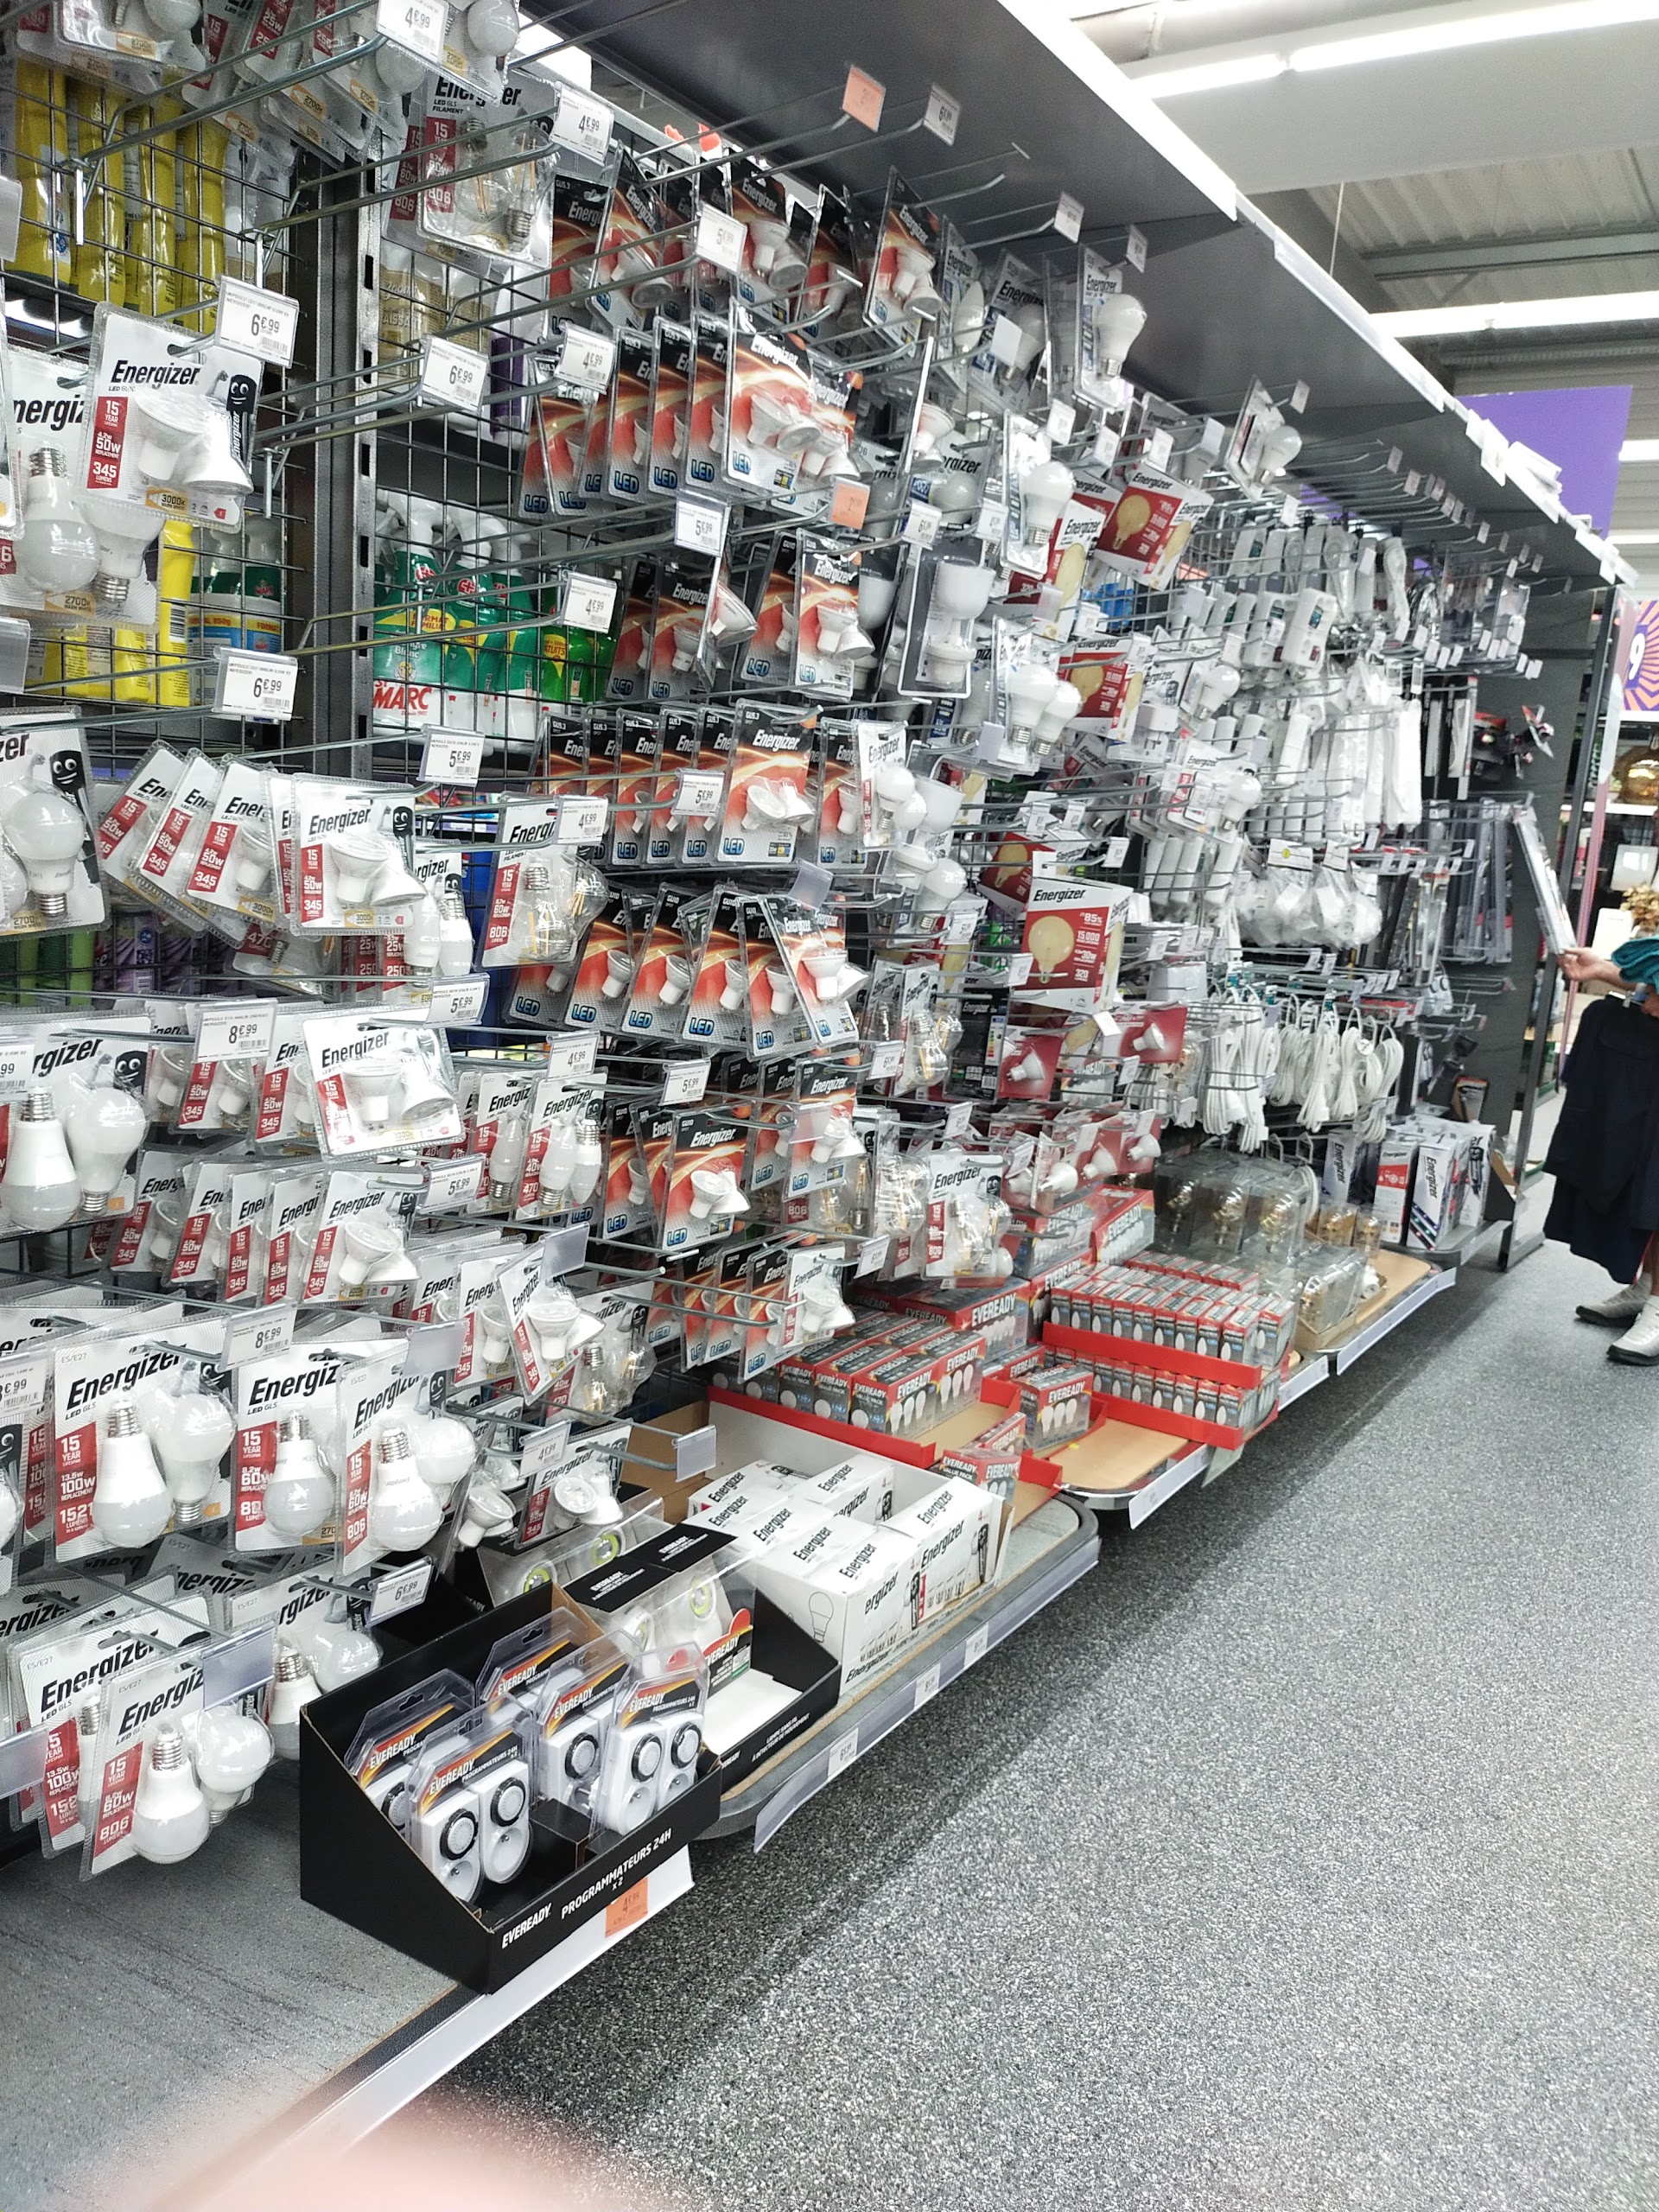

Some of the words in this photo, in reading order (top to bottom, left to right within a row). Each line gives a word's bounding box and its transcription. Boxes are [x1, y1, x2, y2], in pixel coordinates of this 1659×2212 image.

[405, 7, 430, 28] 4€99
[579, 116, 600, 133] 4€99
[251, 314, 279, 335] 6€99
[582, 352, 603, 369] 4€99
[111, 360, 200, 389] Energizer
[449, 366, 473, 385] 6€99
[106, 401, 119, 416] 15
[105, 415, 118, 423] YEAR
[96, 438, 121, 452] 50w
[93, 462, 117, 477] 345
[654, 467, 677, 489] LED
[691, 460, 715, 481] LED
[614, 472, 639, 493] LED
[1134, 473, 1173, 490] Energizer
[696, 519, 712, 536] 5€99
[1064, 518, 1102, 536] Energizer
[253, 677, 282, 697] 6€99
[374, 687, 432, 709] MARC
[753, 730, 800, 751] Energizer
[448, 752, 471, 767] 5€99
[696, 790, 713, 804] 5€99
[308, 809, 371, 836] Energizer
[578, 813, 596, 829] 4€99
[216, 825, 229, 837] 15
[307, 849, 318, 860] 15
[618, 842, 638, 859] LED
[652, 840, 670, 856] LED
[687, 840, 707, 856] LED
[723, 837, 744, 855] LED
[149, 854, 168, 869] 345
[195, 871, 216, 887] 345
[503, 869, 514, 882] 15
[304, 880, 322, 891] 50w
[1033, 889, 1086, 902] Energizer
[304, 899, 322, 911] 345
[490, 926, 508, 938] 806
[450, 995, 473, 1013] 5€99
[963, 1003, 989, 1014] Energizer
[572, 1005, 596, 1022] LED
[629, 1011, 652, 1028] LED
[229, 1024, 257, 1044] 8€99
[689, 1018, 715, 1035] LED
[756, 1031, 774, 1049] LED
[321, 1032, 390, 1068] Energizer
[568, 1052, 585, 1067] 4€99
[271, 1074, 282, 1084] 15
[325, 1081, 336, 1091] 15
[682, 1077, 699, 1092] 5€99
[810, 1077, 847, 1095] Energizer
[185, 1106, 203, 1116] 345
[543, 1089, 593, 1117] Energizer
[261, 1117, 279, 1128] 345
[532, 1133, 543, 1144] 15
[690, 1128, 736, 1147] Energizer
[792, 1175, 809, 1191] LED
[934, 1167, 982, 1189] Energizer
[1427, 1155, 1437, 1198] Energizer
[448, 1177, 470, 1194] 5€99
[523, 1182, 537, 1194] 470
[329, 1192, 385, 1219] Energizer
[194, 1218, 203, 1227] 15
[607, 1215, 627, 1232] LED
[236, 1231, 245, 1241] 15
[276, 1239, 284, 1249] 15
[322, 1231, 332, 1241] 15
[667, 1228, 688, 1245] LED
[177, 1260, 195, 1270] 345
[229, 1277, 246, 1287] 345
[269, 1285, 285, 1295] 345
[309, 1277, 324, 1288] 345
[972, 1294, 1016, 1326] EVEREADY
[255, 1327, 281, 1349] 8€99
[710, 1340, 731, 1357] LED
[61, 1353, 87, 1363] ES/E27
[748, 1353, 766, 1372] LED
[947, 1345, 979, 1371] EVEREADY
[1009, 1357, 1039, 1376] EVEREADY
[67, 1343, 188, 1410] Energizer
[781, 1364, 812, 1377] EVEREADY
[817, 1373, 848, 1388] EVEREADY
[898, 1370, 932, 1398] EVEREADY
[854, 1382, 887, 1398] EVEREADY
[1048, 1382, 1084, 1403] EVEREADY
[65, 1408, 81, 1420] LED
[82, 1402, 97, 1414] GLS
[247, 1406, 263, 1415] LED
[264, 1402, 277, 1410] GLS
[60, 1437, 80, 1452] 15
[242, 1431, 261, 1446] 15
[62, 1449, 80, 1461] YEAR
[243, 1443, 261, 1454] YEAR
[538, 1443, 556, 1461] 4€99
[349, 1456, 362, 1471] 15
[351, 1467, 362, 1477] YEAR
[541, 1450, 594, 1485] Energizer
[944, 1458, 976, 1472] EVEREADY
[818, 1464, 853, 1492] Energizer
[60, 1487, 93, 1501] REPLACEMENT
[708, 1471, 746, 1503] Energizer
[60, 1503, 93, 1524] 1521
[708, 1495, 748, 1527] Energizer
[917, 1491, 954, 1525] Energizer
[977, 1510, 983, 1521] 4
[346, 1518, 366, 1539] 806
[753, 1507, 792, 1542] Energizer
[793, 1527, 832, 1561] Energizer
[921, 1520, 964, 1568] Energizer
[839, 1542, 877, 1580] Energizer
[395, 1581, 418, 1600] 6€99
[27, 1656, 54, 1670] ES/E27
[41, 1630, 160, 1713] Energizer
[118, 1679, 142, 1694] ES/E27
[497, 1663, 538, 1696] EVEREADY
[554, 1686, 594, 1719] EVEREADY
[629, 1691, 665, 1713] EVEREADY
[41, 1708, 57, 1722] LED
[58, 1700, 73, 1713] GLS
[116, 1732, 131, 1745] LED
[370, 1732, 416, 1770] EVEREADY
[108, 1758, 127, 1772] 15
[461, 1749, 507, 1783] PROGRAMMATEURS
[108, 1770, 125, 1783] YEAR
[430, 1758, 475, 1795] EVEREADY
[100, 1817, 129, 1840] 806
[561, 1847, 652, 1920] PROGRAMMATEURS
[652, 1827, 673, 1856] 24H
[501, 1903, 552, 1949] EVEREADY
